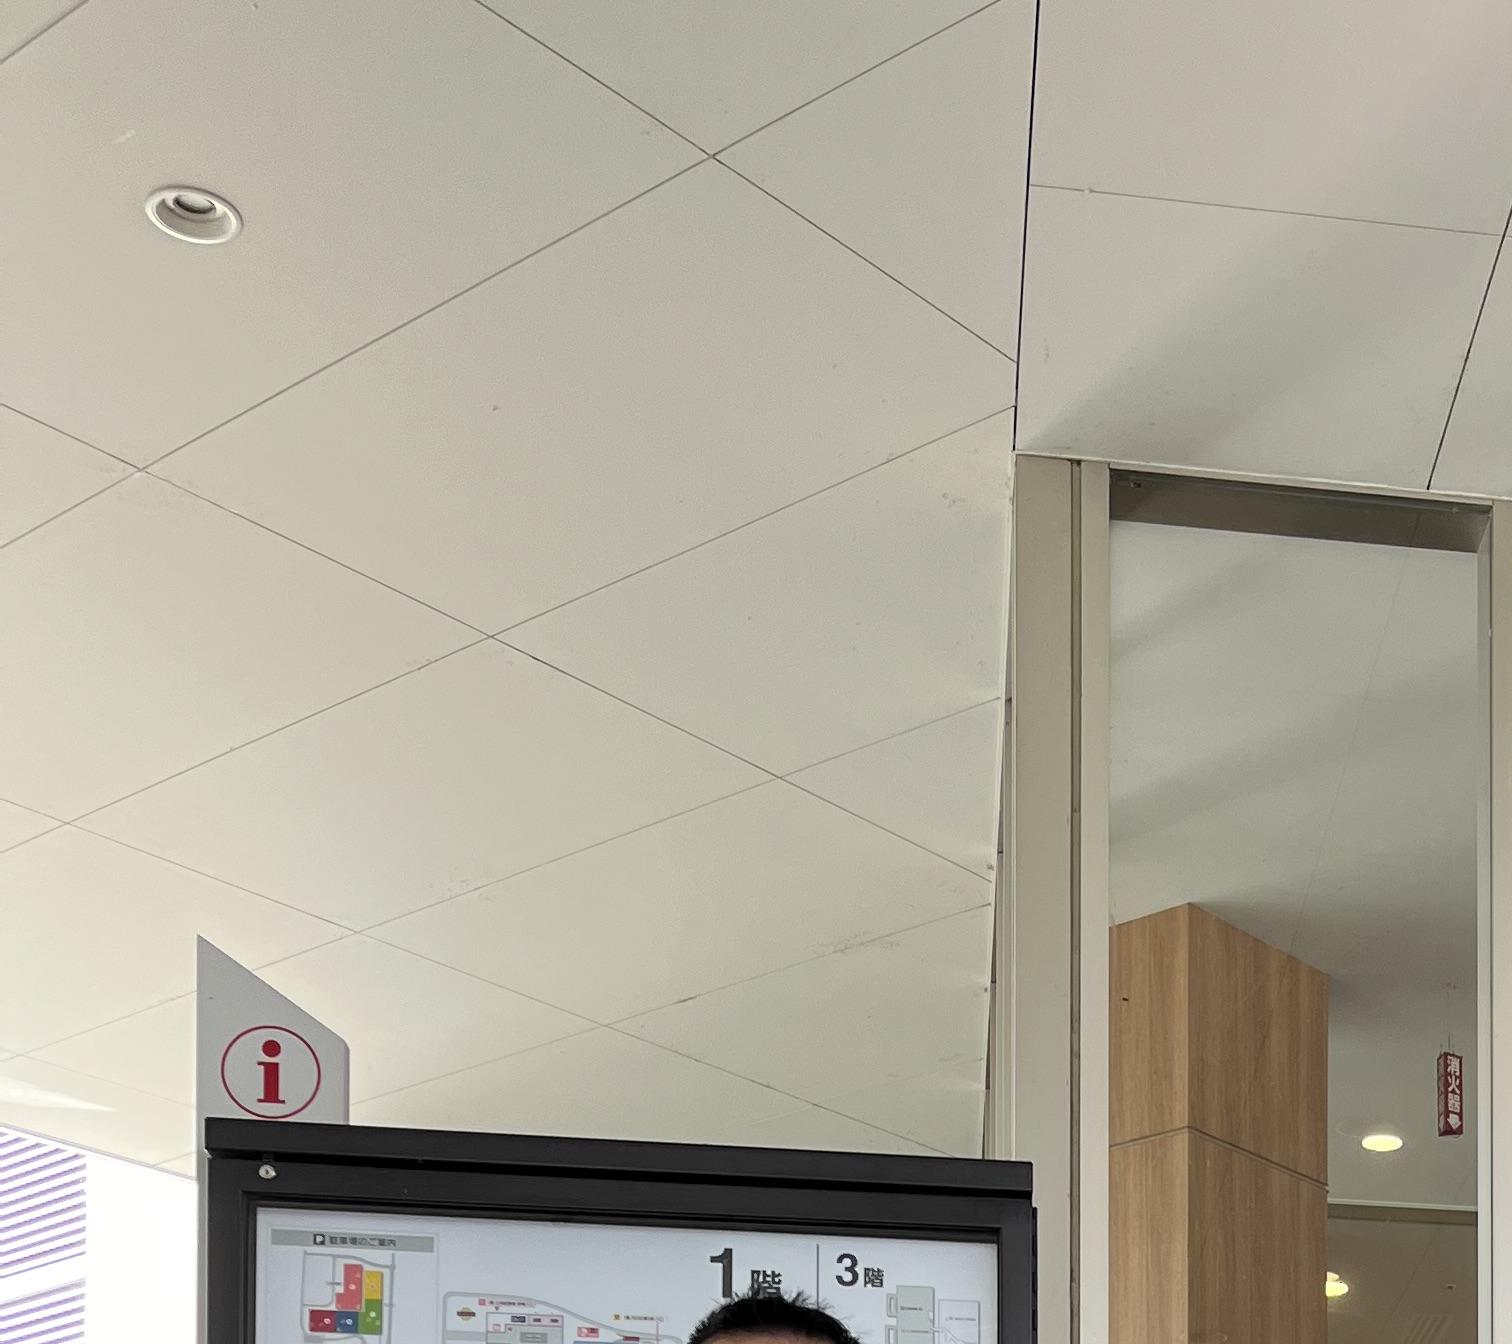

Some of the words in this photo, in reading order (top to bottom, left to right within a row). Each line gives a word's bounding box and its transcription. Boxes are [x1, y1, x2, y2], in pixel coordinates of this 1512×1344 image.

[1446, 1055, 1461, 1113] 消火器
[836, 1252, 885, 1289] 3階
